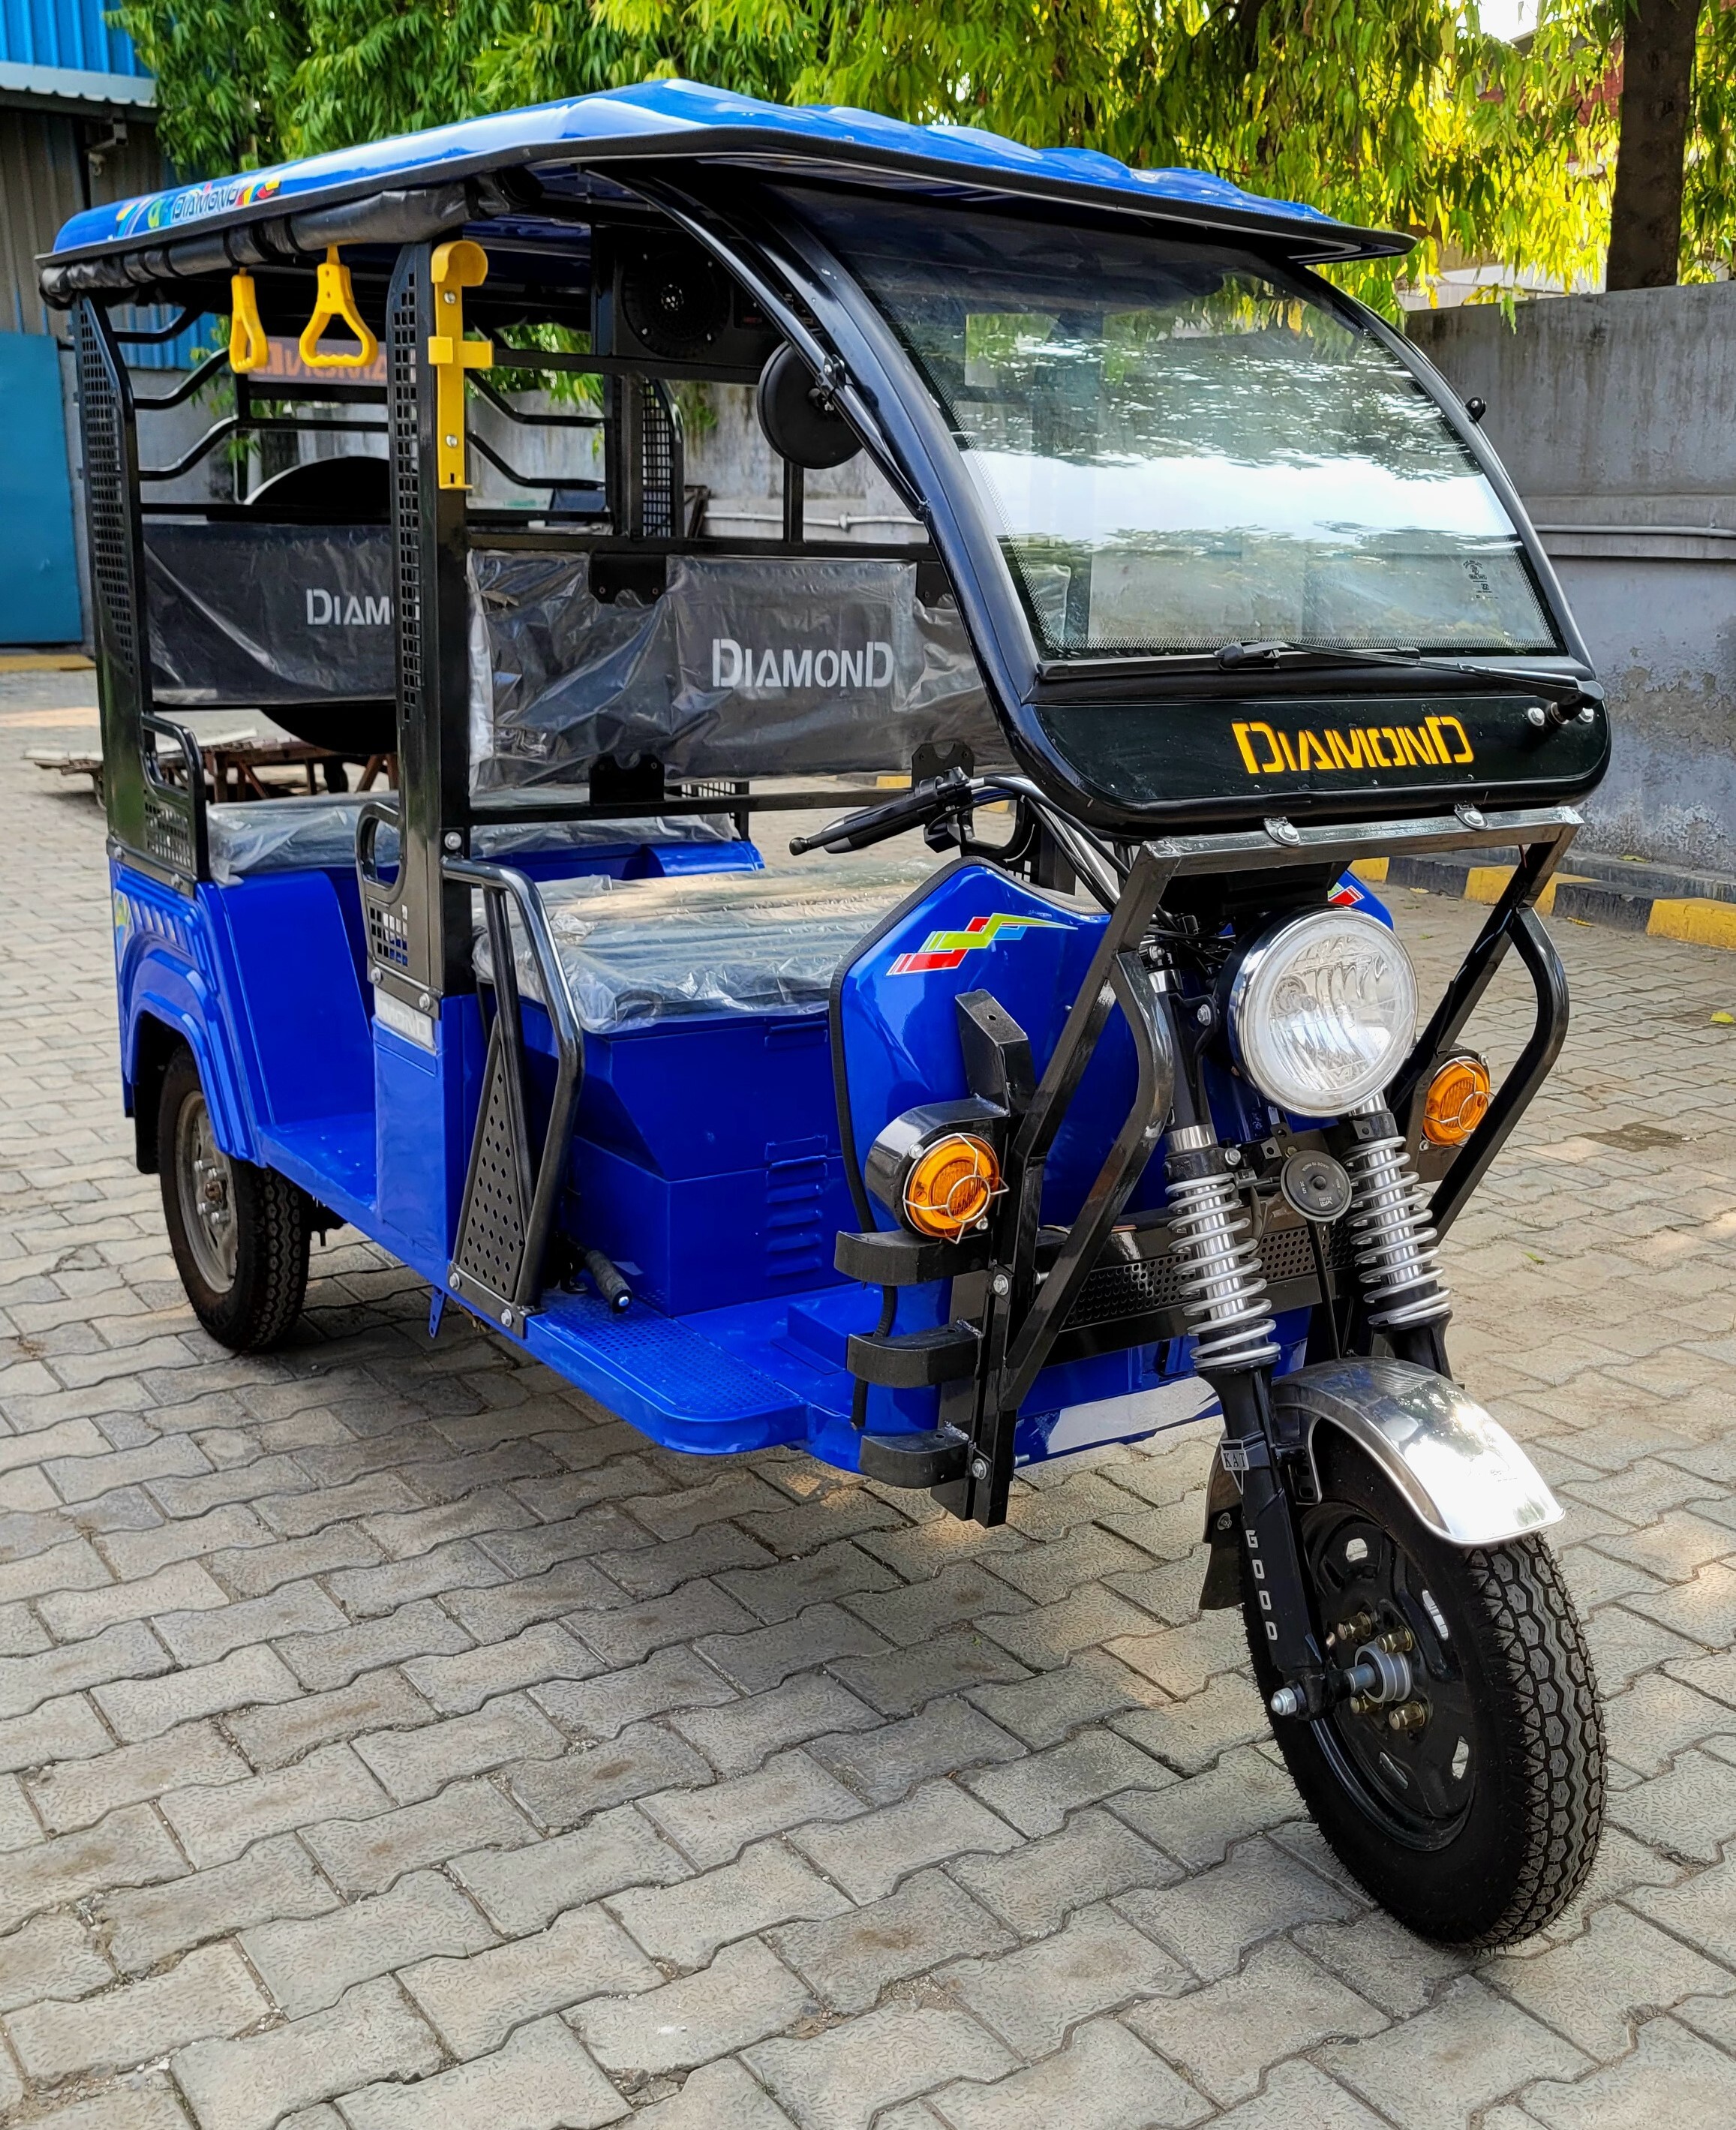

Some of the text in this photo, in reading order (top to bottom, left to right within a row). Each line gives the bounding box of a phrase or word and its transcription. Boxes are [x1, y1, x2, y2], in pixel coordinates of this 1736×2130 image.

[173, 188, 238, 220] DIAMOND
[306, 588, 395, 626] DIAM
[713, 638, 894, 688] DIAMOND
[1231, 716, 1474, 774] DIAMOND
[1223, 1453, 1246, 1468] KAT
[1245, 1529, 1278, 1641] GOOD
